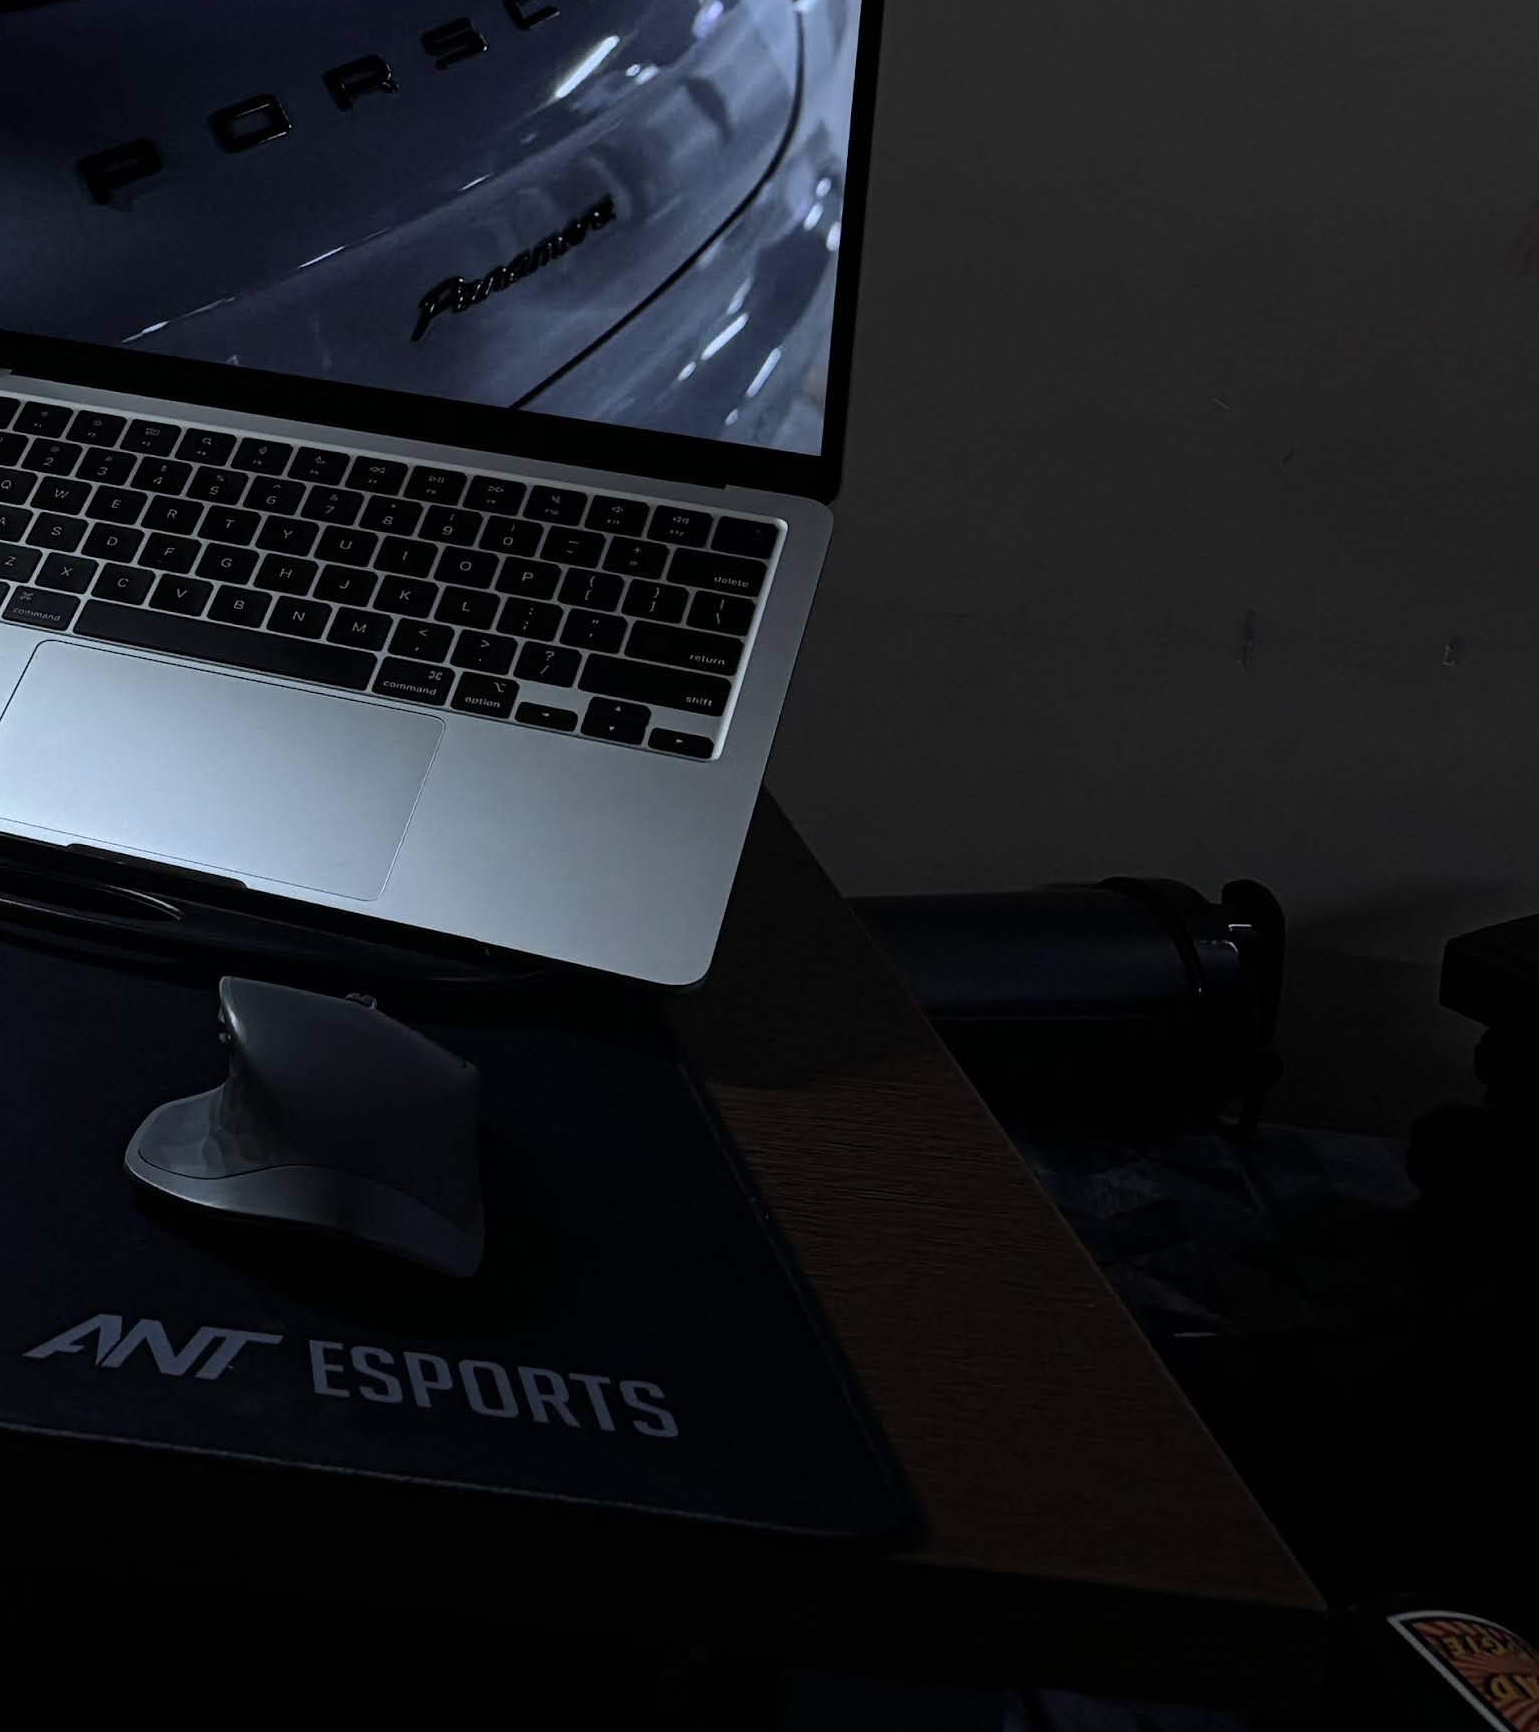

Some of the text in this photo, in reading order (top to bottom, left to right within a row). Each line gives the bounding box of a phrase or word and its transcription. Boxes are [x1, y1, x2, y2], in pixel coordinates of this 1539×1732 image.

[411, 194, 615, 342] Panamera
[167, 509, 177, 518] R
[117, 577, 127, 589] C
[715, 577, 748, 587] delete
[13, 608, 60, 621] command
[352, 622, 366, 633] M
[690, 655, 724, 665] return
[383, 681, 436, 695] command
[465, 697, 500, 707] option
[686, 697, 712, 706] shift
[22, 1313, 680, 1438] ANT ESPORTS
